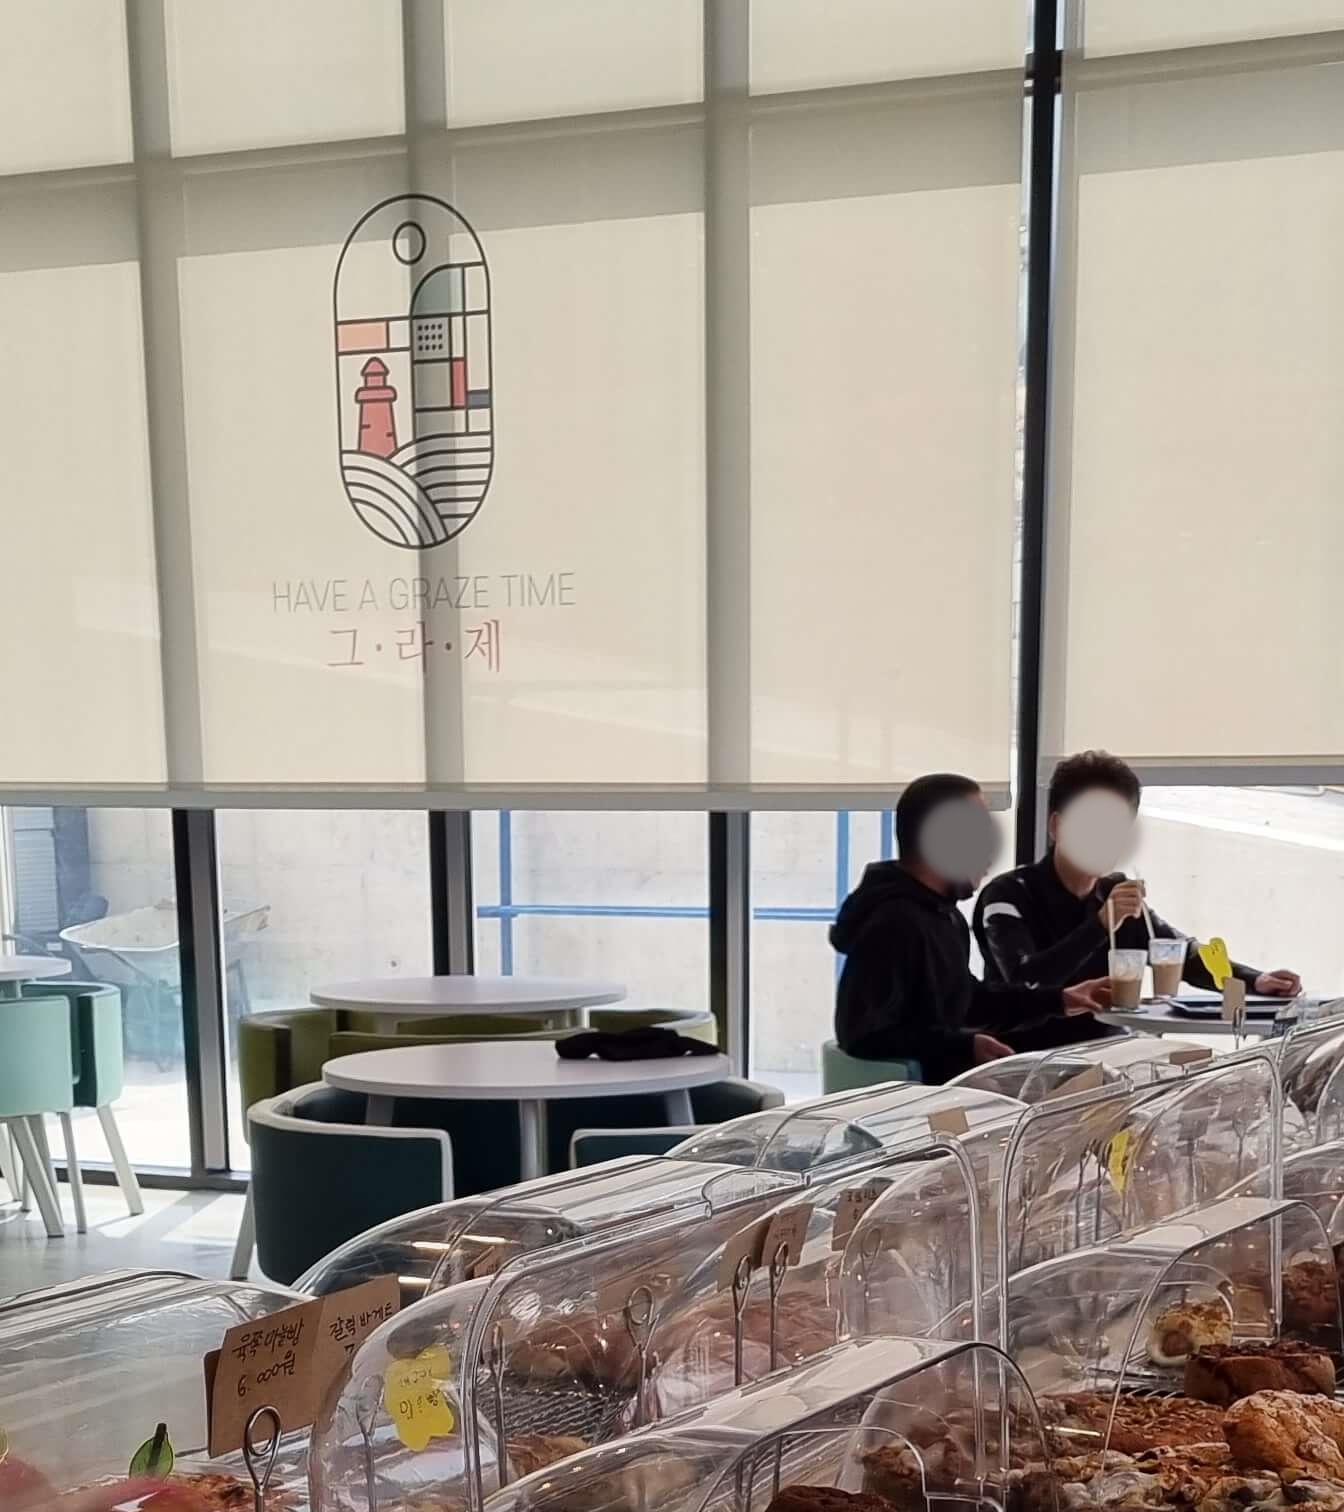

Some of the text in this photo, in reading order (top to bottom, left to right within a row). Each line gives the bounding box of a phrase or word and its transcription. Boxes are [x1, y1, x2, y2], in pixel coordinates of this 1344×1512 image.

[272, 571, 577, 614] HAVE A GRAZE TIME
